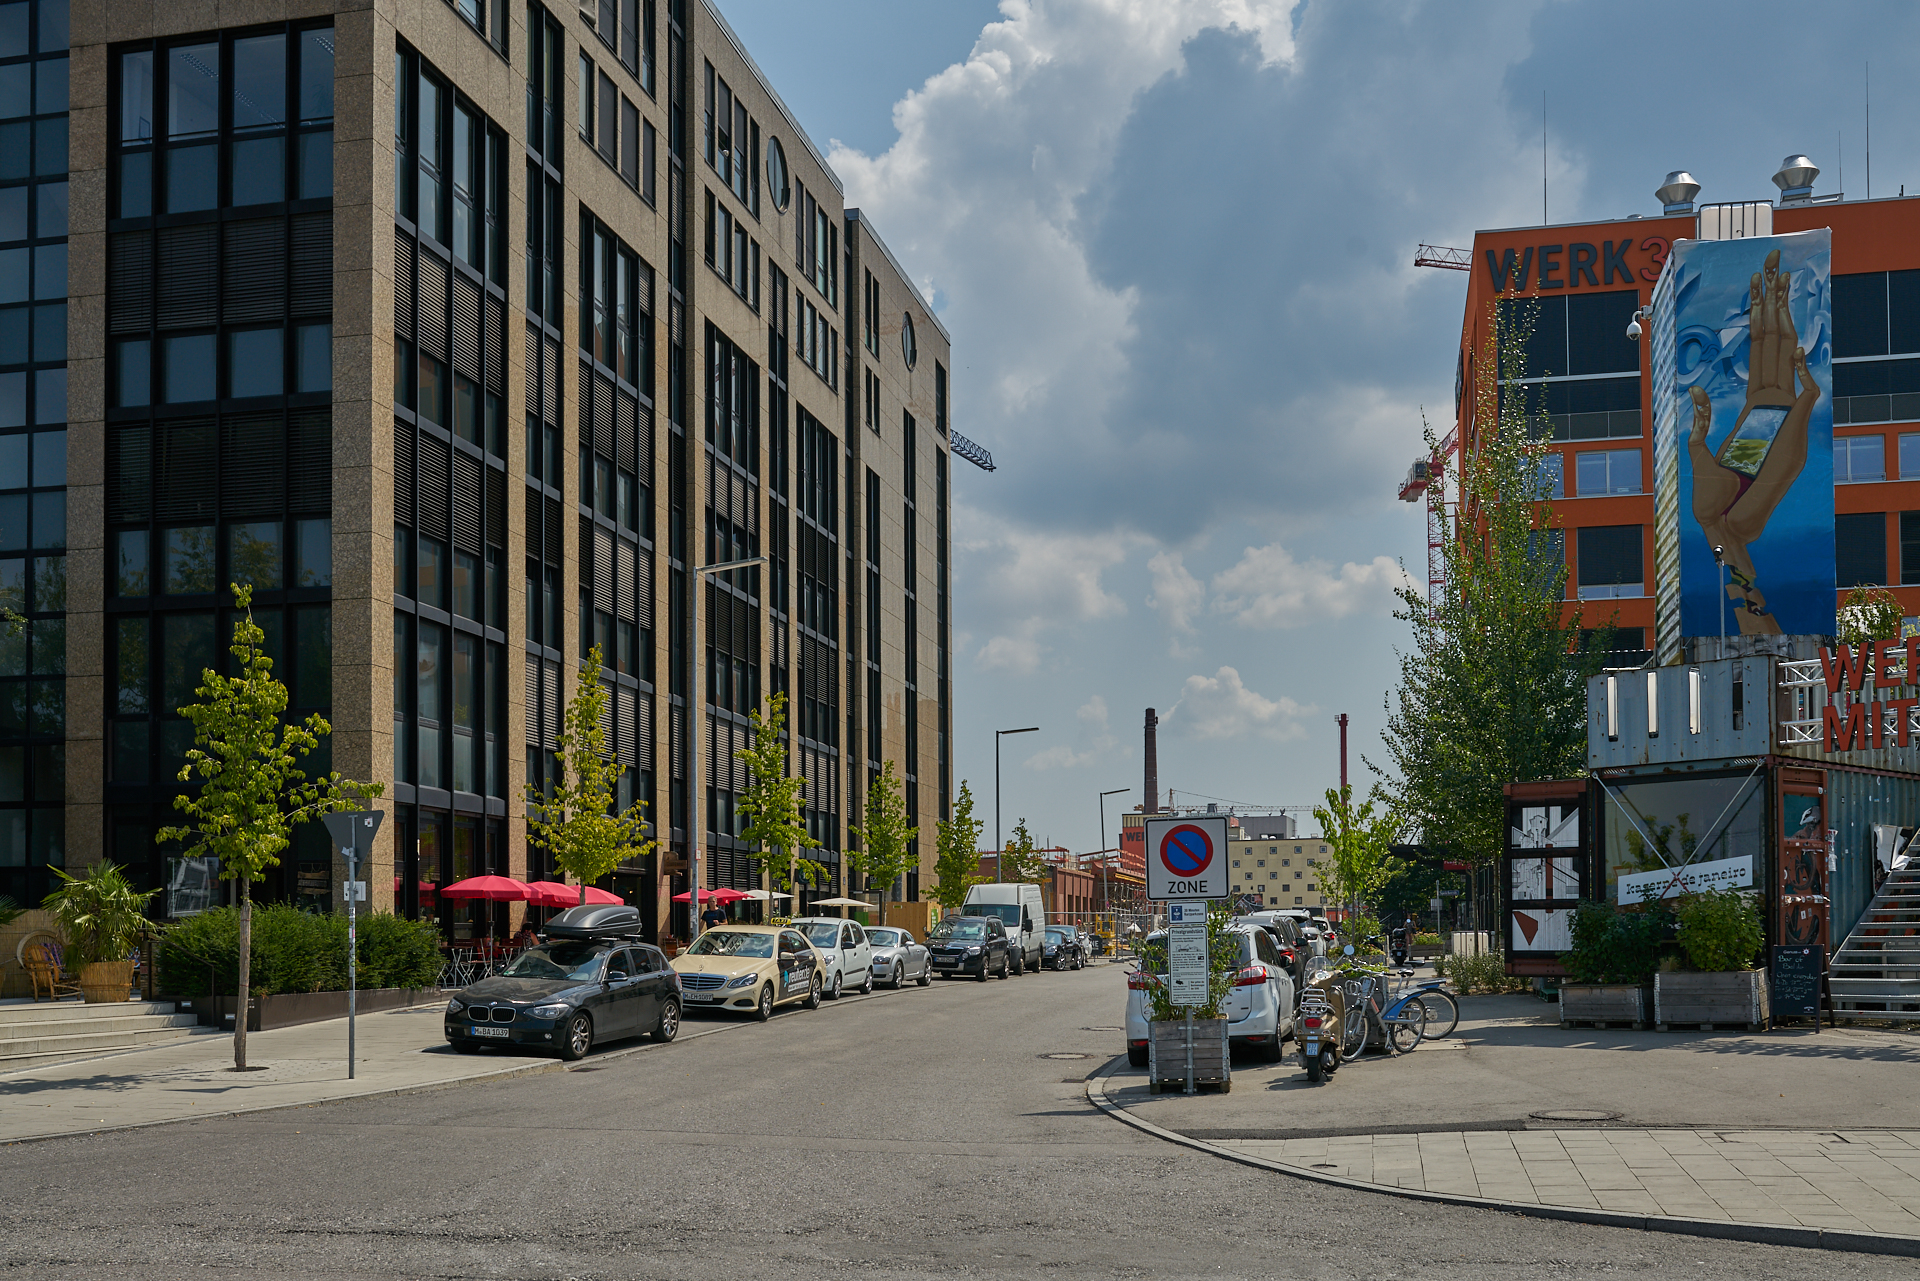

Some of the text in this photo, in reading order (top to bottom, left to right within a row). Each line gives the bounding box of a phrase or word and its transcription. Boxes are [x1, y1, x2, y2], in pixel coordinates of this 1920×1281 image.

[1681, 873, 1696, 886] de
[1698, 867, 1746, 886] janeiro
[1167, 880, 1208, 894] ZONE
